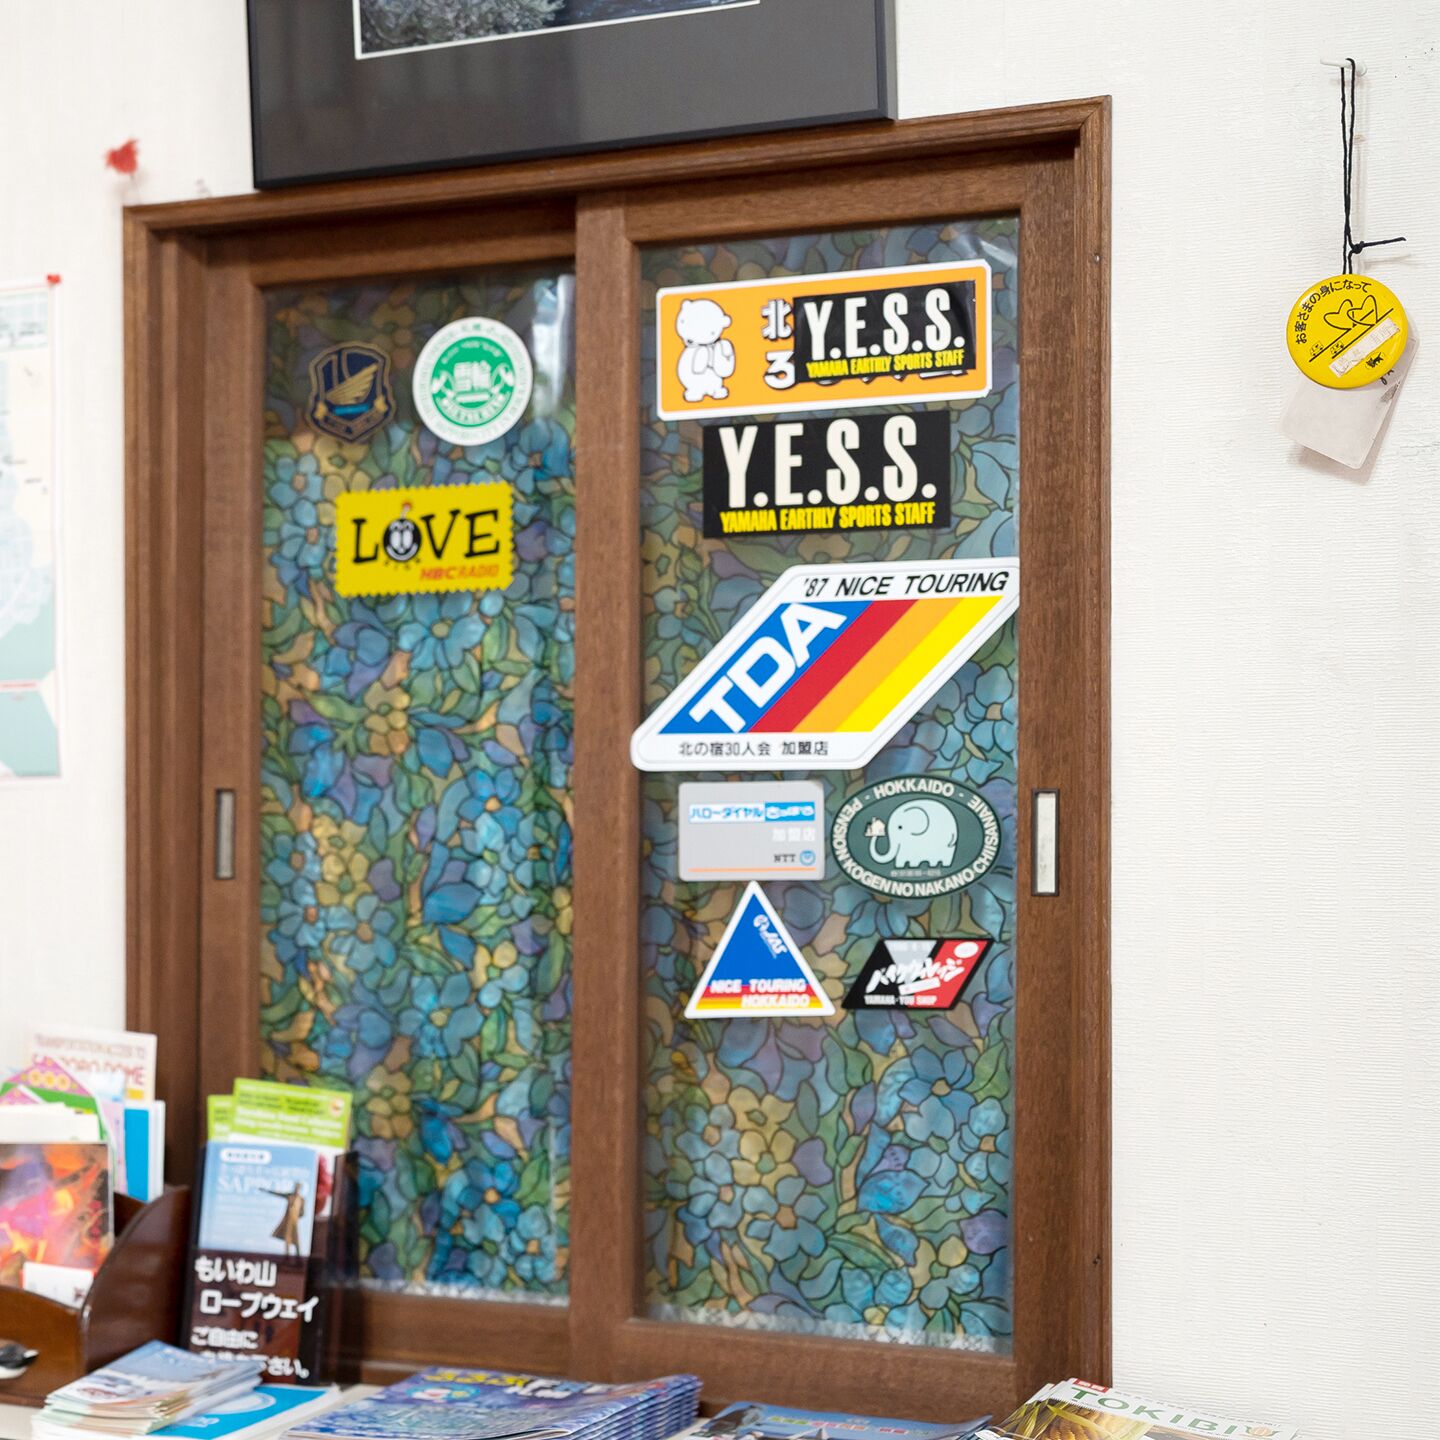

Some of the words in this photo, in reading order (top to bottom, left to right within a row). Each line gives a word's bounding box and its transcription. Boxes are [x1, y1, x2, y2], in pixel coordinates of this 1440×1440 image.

[804, 288, 965, 360] Y.E.S.S.
[1294, 279, 1371, 345] お客さまの身になって
[807, 361, 849, 379] YAMAHA
[851, 356, 891, 374] EARTHLY
[894, 353, 932, 370] SPORTS
[935, 349, 965, 367] STAFF
[719, 415, 937, 509] Y.E.S.S.
[721, 510, 777, 533] YAMAHA
[780, 508, 836, 531] EARTHLY
[839, 504, 891, 528] SPORTS
[894, 502, 935, 526] STAFF
[804, 577, 826, 597] '87
[835, 575, 894, 597] NICE
[904, 571, 1010, 596] TOURING
[689, 603, 847, 733] TDA
[679, 741, 771, 756] 北の宿30人会
[782, 741, 828, 756] 加盟店
[873, 778, 955, 799] HOKKAIDO
[691, 806, 764, 820] ハローダイヤル
[774, 853, 796, 863] NTT
[832, 797, 864, 862] PENSION
[915, 868, 975, 896] NAKANO
[967, 794, 1000, 875] CHIISANAIE
[710, 979, 742, 994] NICE
[749, 978, 806, 993] TOURING
[741, 994, 810, 1008] HOKKAIDO
[195, 1256, 278, 1287] もいわ山
